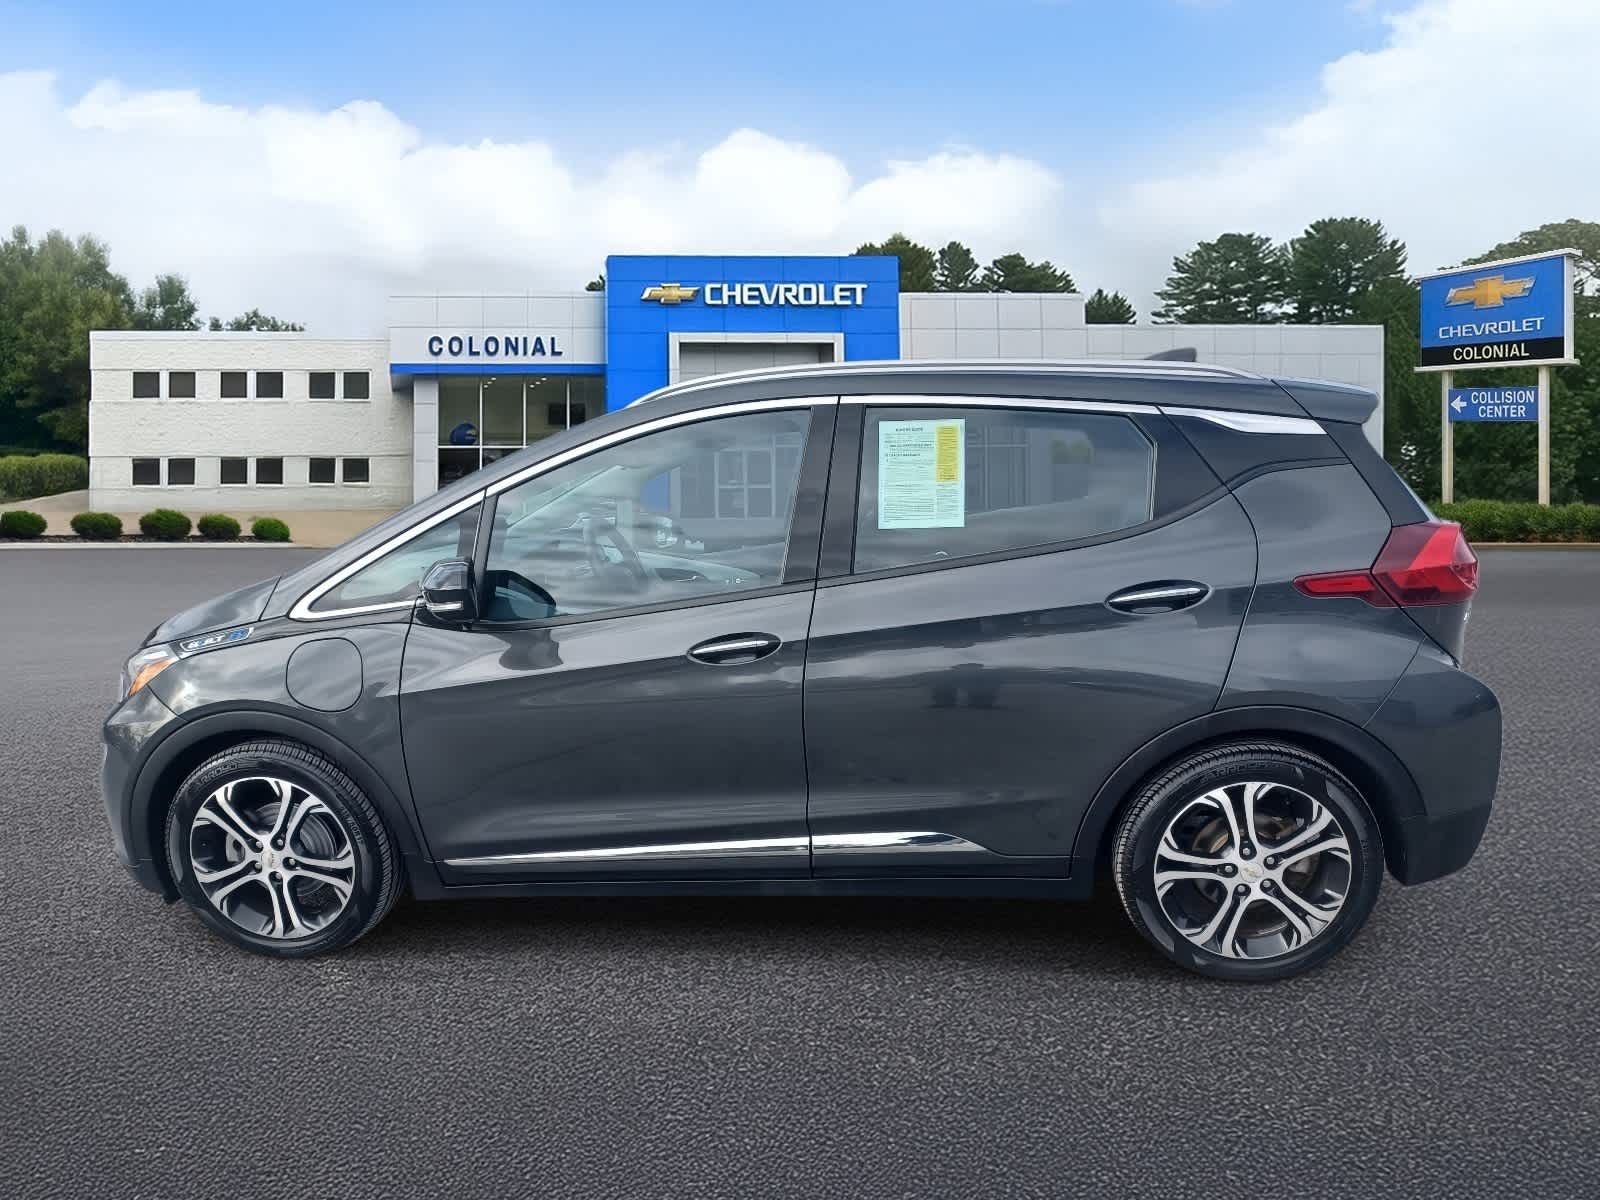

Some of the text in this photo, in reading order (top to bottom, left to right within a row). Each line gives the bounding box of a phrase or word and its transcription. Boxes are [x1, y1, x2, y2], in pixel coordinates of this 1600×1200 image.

[704, 283, 868, 306] CHEVROLET
[1438, 317, 1545, 339] CHEVROLET
[428, 335, 563, 357] COLONIAL
[1453, 343, 1530, 361] COLONIAL
[1471, 390, 1535, 404] COLLISION
[1478, 405, 1526, 418] CENTER
